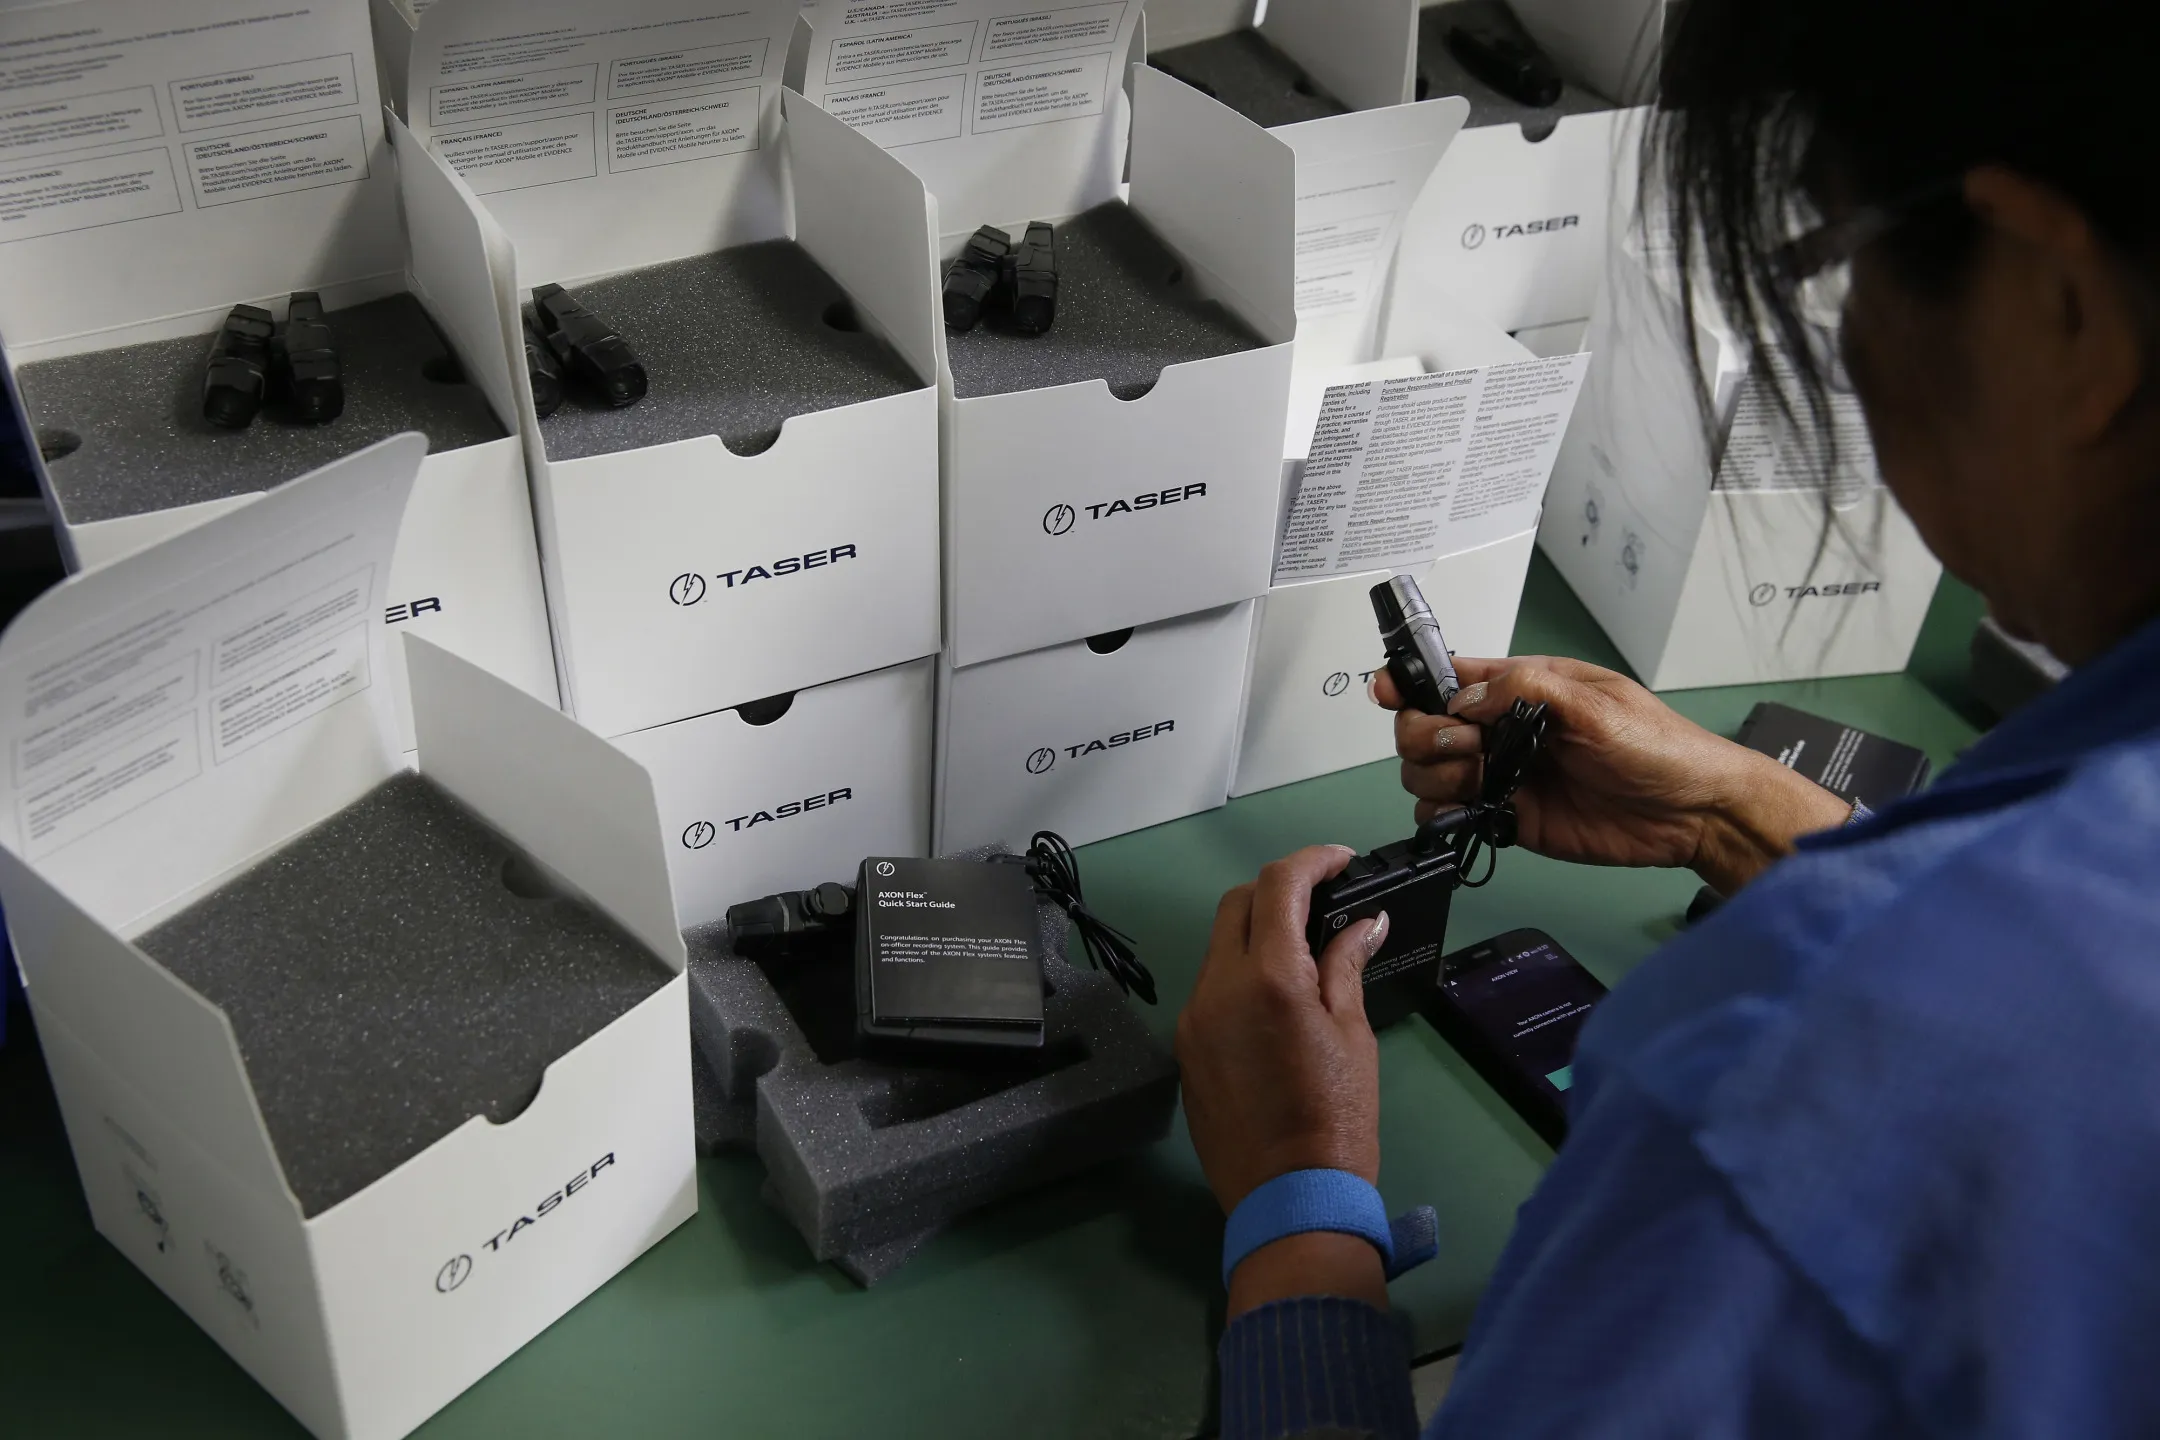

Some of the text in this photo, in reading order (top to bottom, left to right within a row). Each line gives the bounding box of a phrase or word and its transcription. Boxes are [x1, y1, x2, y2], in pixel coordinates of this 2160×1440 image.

[983, 71, 1011, 81] DEUTSCHE
[615, 108, 647, 118] DEUTSCHE
[1493, 214, 1579, 239] TASER
[1084, 482, 1207, 520] TASER
[716, 543, 857, 588] TASER
[1784, 580, 1882, 599] TASER
[1063, 719, 1175, 759] TASER
[724, 787, 852, 832] TASER
[878, 891, 904, 899] AXON
[878, 899, 956, 909] Quick Start Guide
[941, 936, 976, 944] purchasing
[1003, 952, 1029, 960] features
[482, 1152, 614, 1252] TASER
